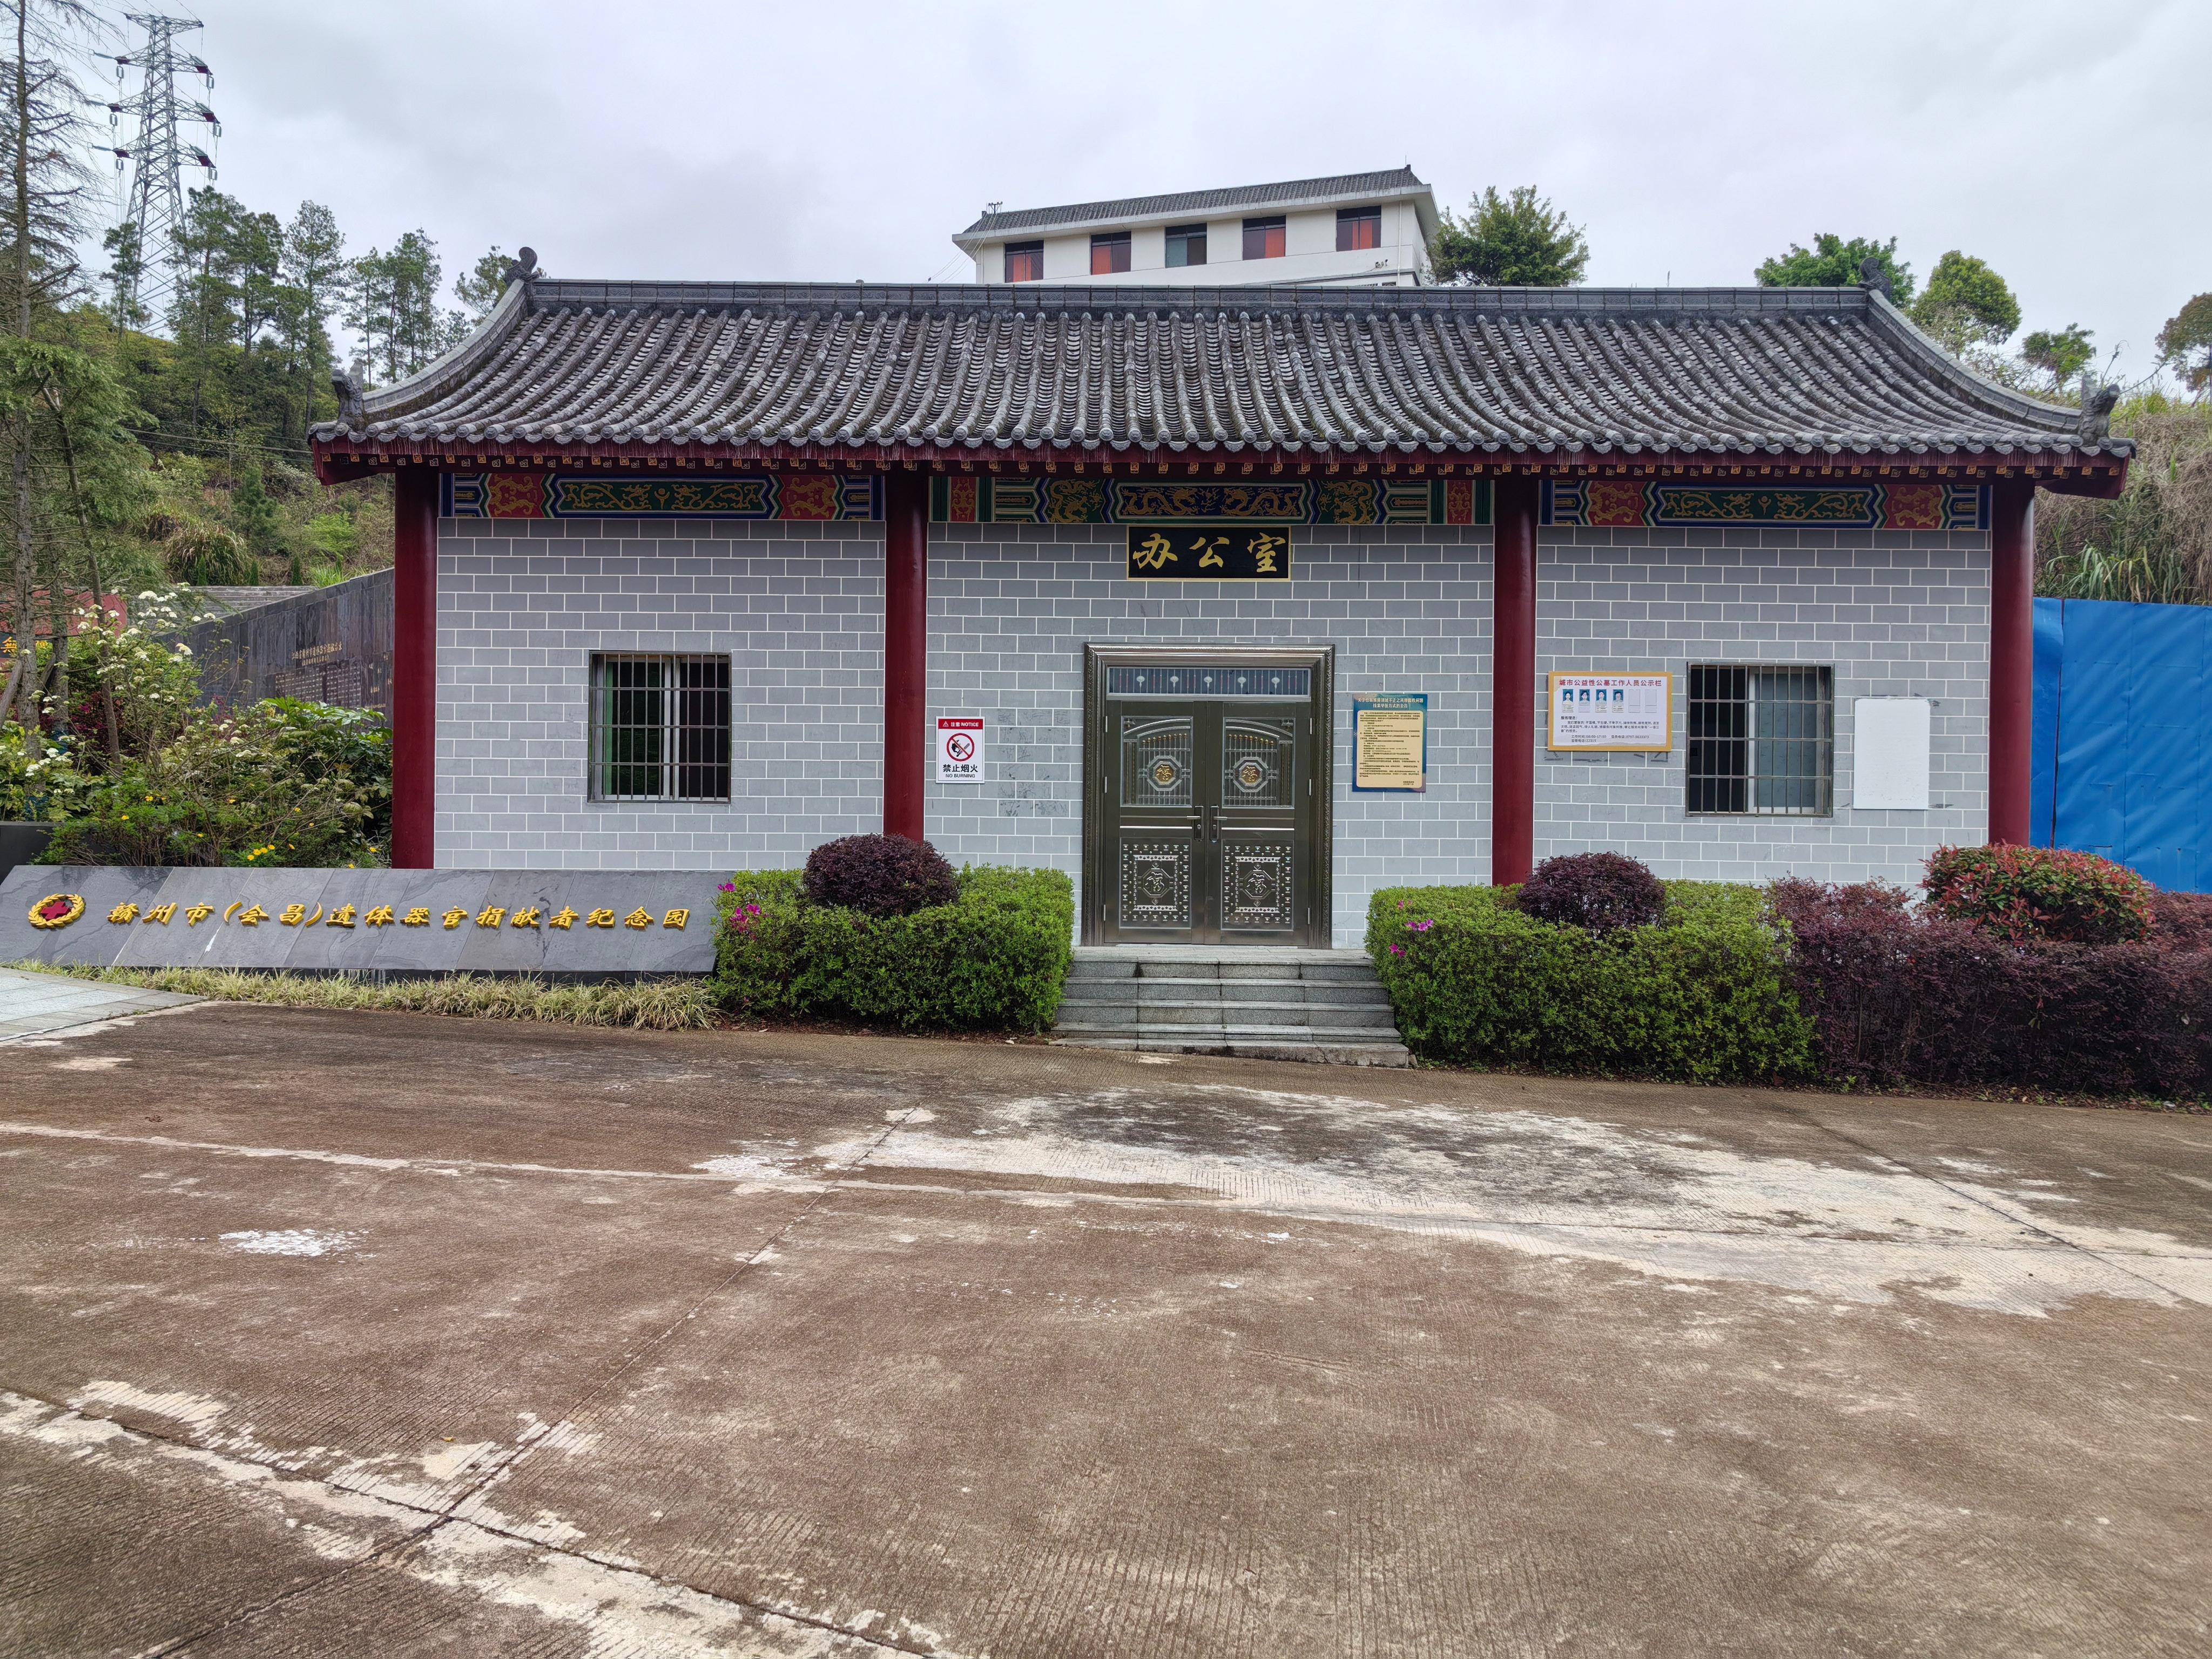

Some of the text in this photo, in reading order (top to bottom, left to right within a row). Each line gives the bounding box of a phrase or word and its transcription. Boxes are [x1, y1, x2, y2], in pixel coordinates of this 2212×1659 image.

[1132, 532, 1286, 572] 办公室
[1559, 679, 1662, 687] 城市公益性公墓工作人员公示栏
[943, 764, 978, 773] 禁止烟火
[106, 901, 691, 930] 赣州市（会昌）遗体器官捐献者纪念园
